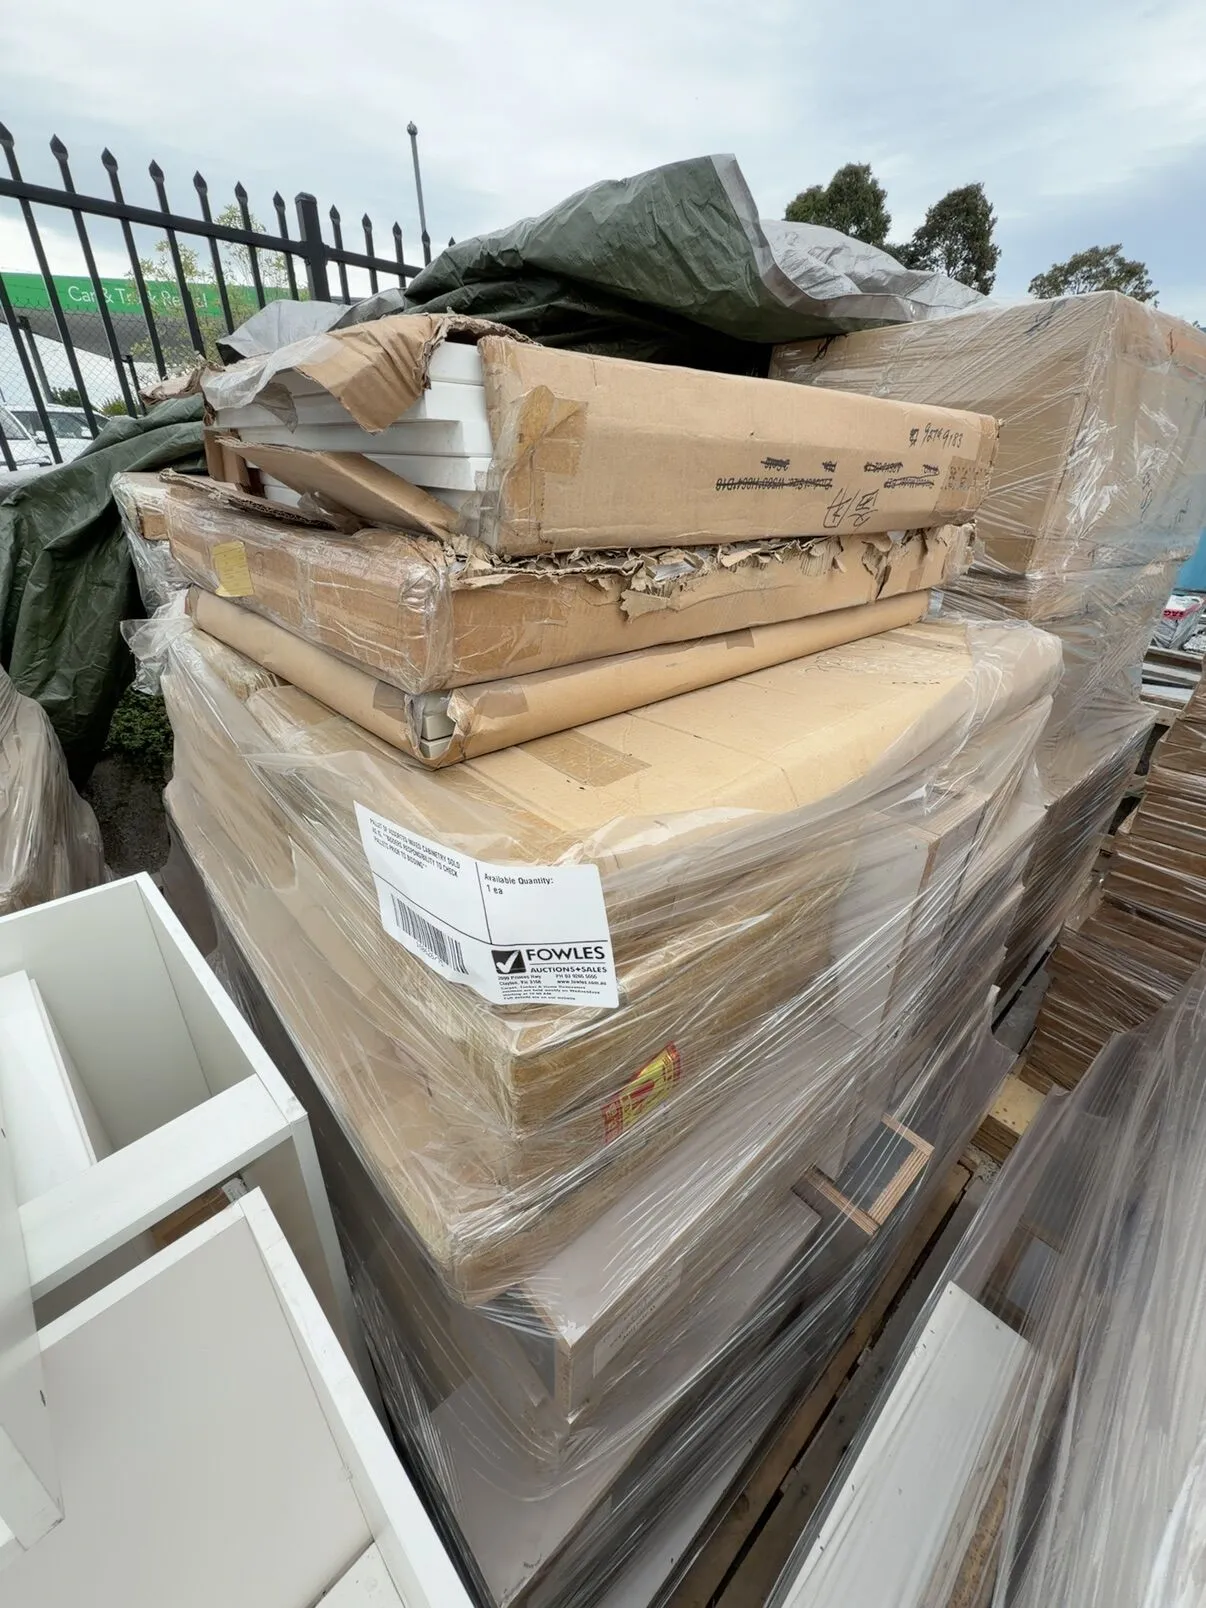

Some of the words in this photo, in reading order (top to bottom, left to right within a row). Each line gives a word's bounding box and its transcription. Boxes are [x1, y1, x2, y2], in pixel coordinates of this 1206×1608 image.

[68, 286, 98, 302] Car
[102, 288, 114, 304] &
[443, 864, 458, 877] CHECK
[484, 873, 516, 885] Available
[517, 877, 554, 886] Quantity:
[486, 884, 491, 892] 1
[493, 887, 503, 895] ea
[526, 946, 605, 961] FOWLES
